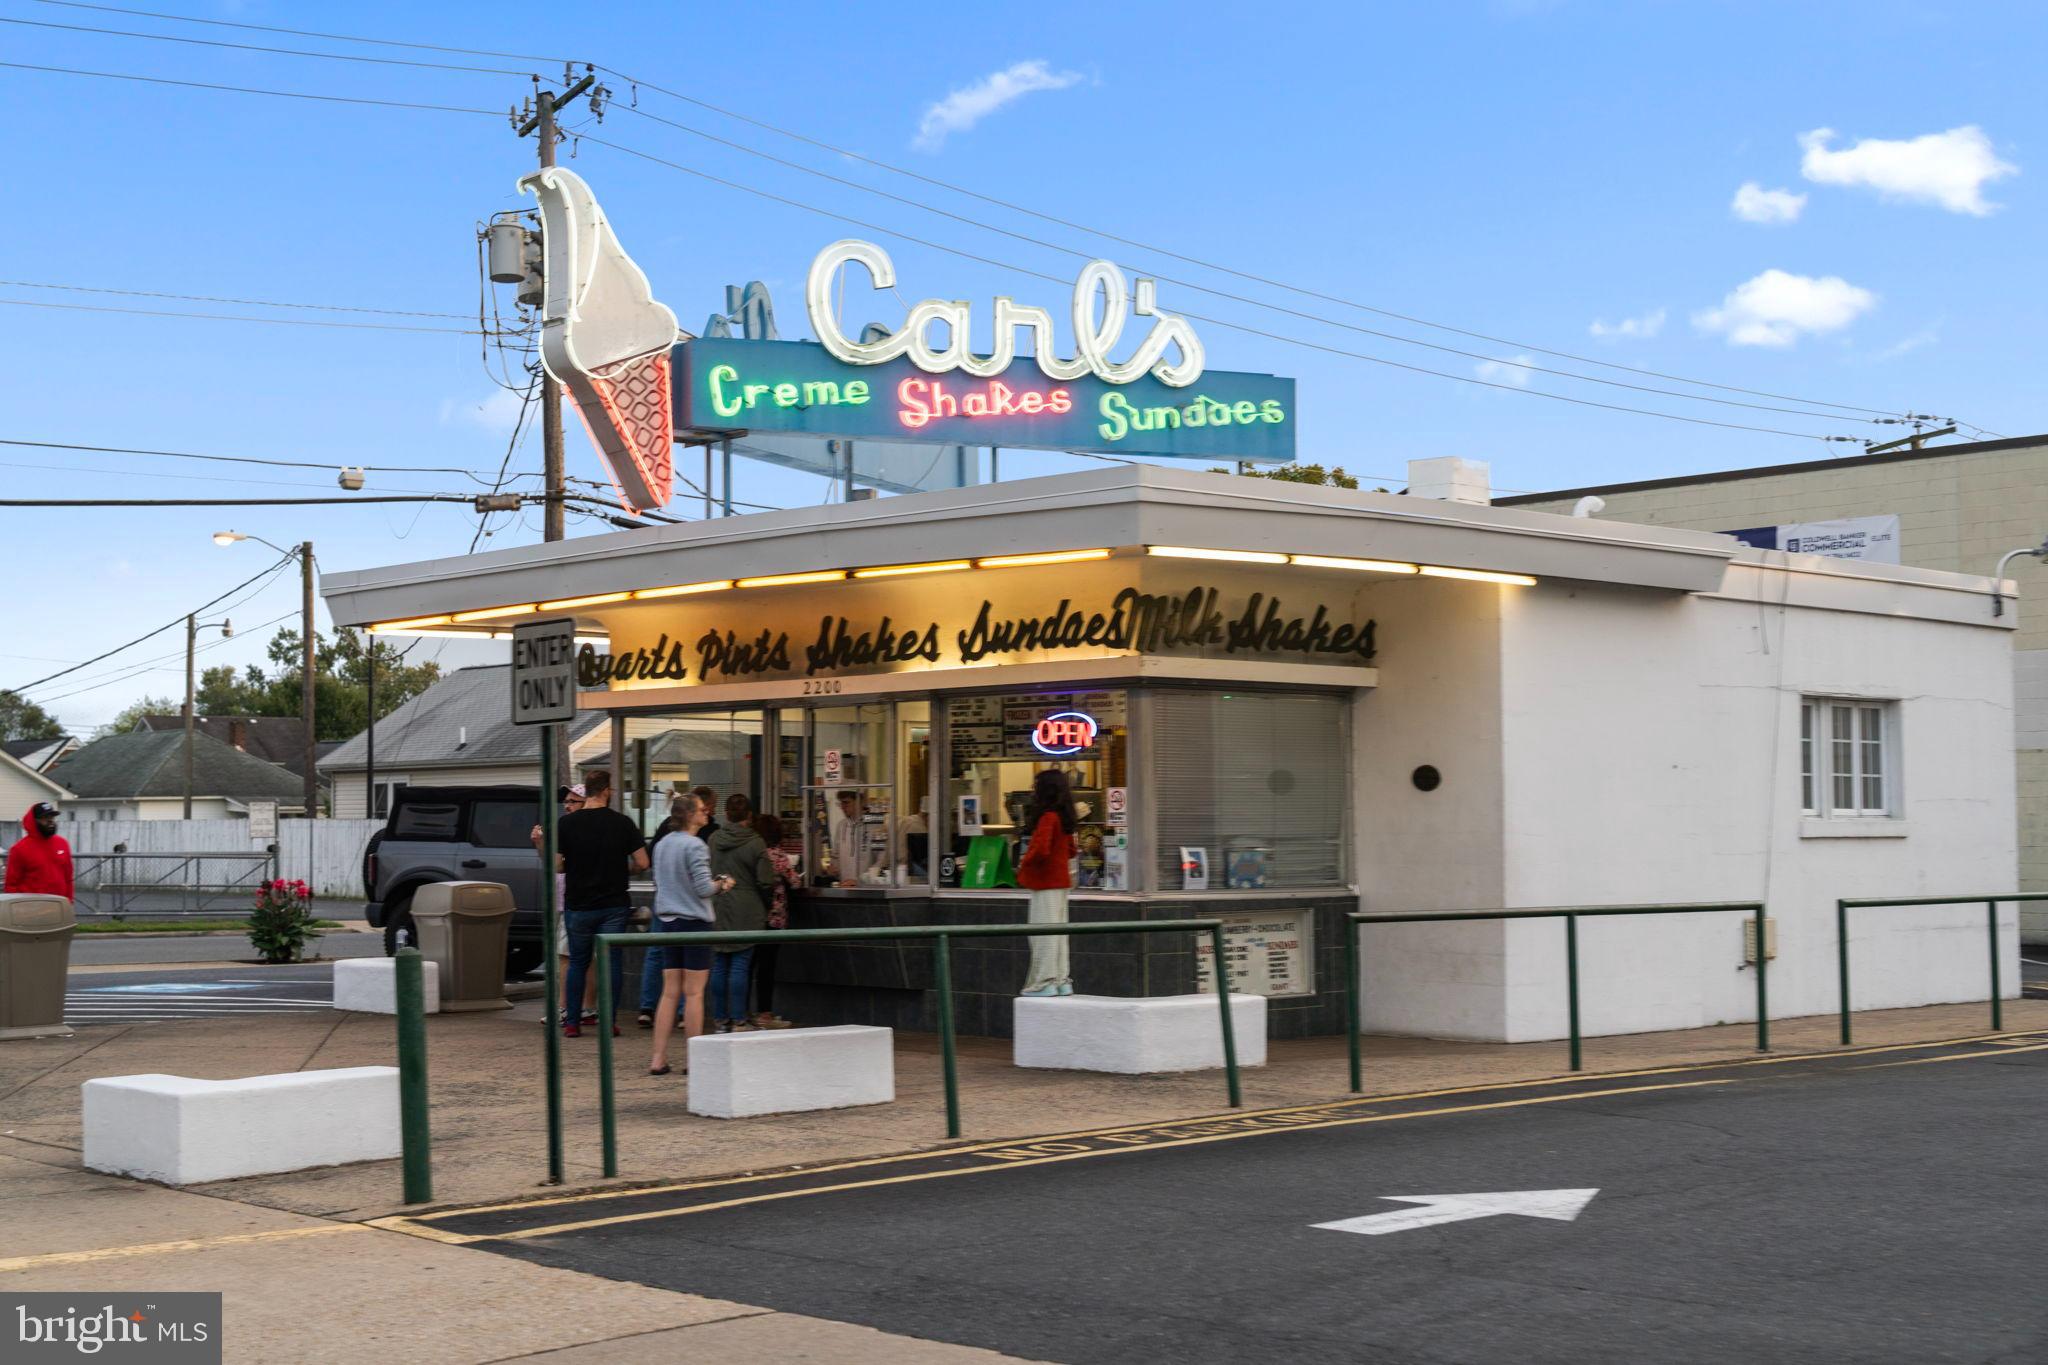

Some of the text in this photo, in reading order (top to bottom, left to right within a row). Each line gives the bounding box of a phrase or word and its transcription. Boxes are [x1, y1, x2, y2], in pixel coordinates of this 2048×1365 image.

[806, 238, 1205, 387] Carl's
[709, 364, 1284, 441] Creme Shakes Sundaes
[1802, 535, 1837, 543] COLDWELL
[1839, 531, 1866, 540] BANKER
[1802, 540, 1866, 552] COMMERCIAL
[1113, 586, 1377, 659] Milk Shakes
[517, 634, 573, 670] ENTER
[578, 600, 1130, 687] Quarts Pints Shakes Sundaes
[520, 675, 568, 710] ONLY
[803, 680, 841, 695] 2200
[1037, 720, 1093, 747] OPEN
